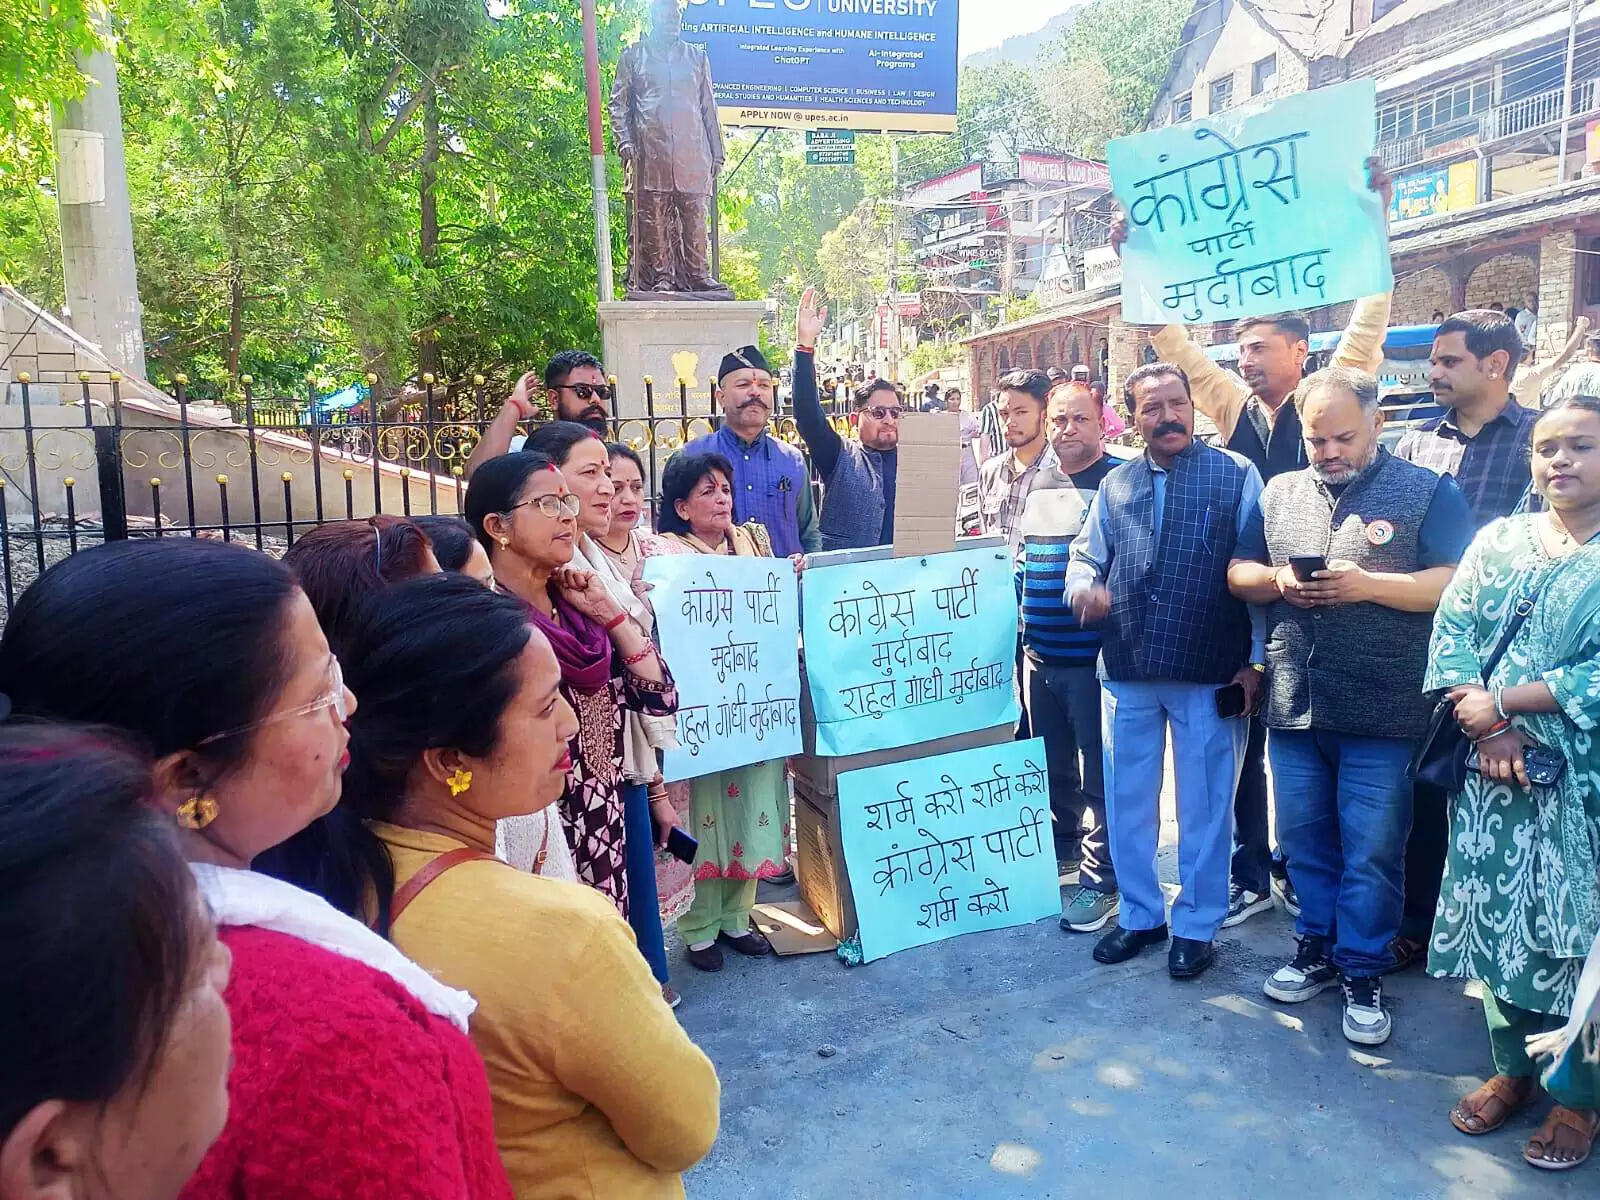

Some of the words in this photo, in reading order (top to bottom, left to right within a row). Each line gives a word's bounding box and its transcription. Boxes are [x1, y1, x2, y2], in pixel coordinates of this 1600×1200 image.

[700, 23, 750, 34] ARTIFICIAL
[751, 25, 815, 37] INTELLIGENCE
[816, 28, 833, 38] and
[834, 29, 873, 39] HUMANE
[874, 31, 937, 42] INTELLIGENCE
[827, 0, 938, 16] UNIVERSITY
[770, 45, 797, 54] Learning
[876, 59, 916, 69] Programs
[712, 82, 741, 90] DVANCED
[741, 83, 782, 92] ENGINEERING
[789, 86, 822, 94] COMPUTER
[823, 87, 849, 95] SCIENCE
[855, 88, 886, 96] BUSINESS
[892, 89, 906, 97] LAW
[913, 90, 936, 98] DESIGN
[734, 92, 760, 100] STUDIES
[775, 94, 813, 102] HUMANITIES
[819, 96, 843, 104] HEALTH
[844, 97, 873, 105] SCIENCES
[873, 98, 887, 106] AND
[887, 99, 926, 107] TECHNOLOGY
[740, 110, 768, 119] APPLY
[770, 111, 792, 120] NOW
[804, 113, 849, 123] upes.ac.in
[1130, 128, 1310, 232] कांग्रेस
[1187, 221, 1256, 255] पार्टी
[1162, 248, 1331, 321] मुर्दाबाद
[682, 571, 733, 627] कांग्रेस
[744, 571, 781, 625] पार्टी
[829, 580, 915, 638] कांग्रेस
[931, 567, 979, 620] पार्टी
[711, 630, 758, 683] मुर्दाबाद
[871, 629, 953, 676] मुर्दाबाद
[714, 682, 748, 738] गांधी
[749, 683, 797, 741] मुर्दाबाद
[839, 680, 896, 719] राहुल
[904, 666, 943, 705] गांधी
[949, 657, 1005, 704] मुर्दाबाद
[864, 780, 916, 831] शर्म
[924, 774, 965, 819] करो
[970, 764, 1012, 808] शर्म
[1014, 759, 1047, 797] करो
[981, 806, 1044, 864] पार्टी
[916, 886, 960, 928] शर्म
[967, 877, 1010, 917] करो
